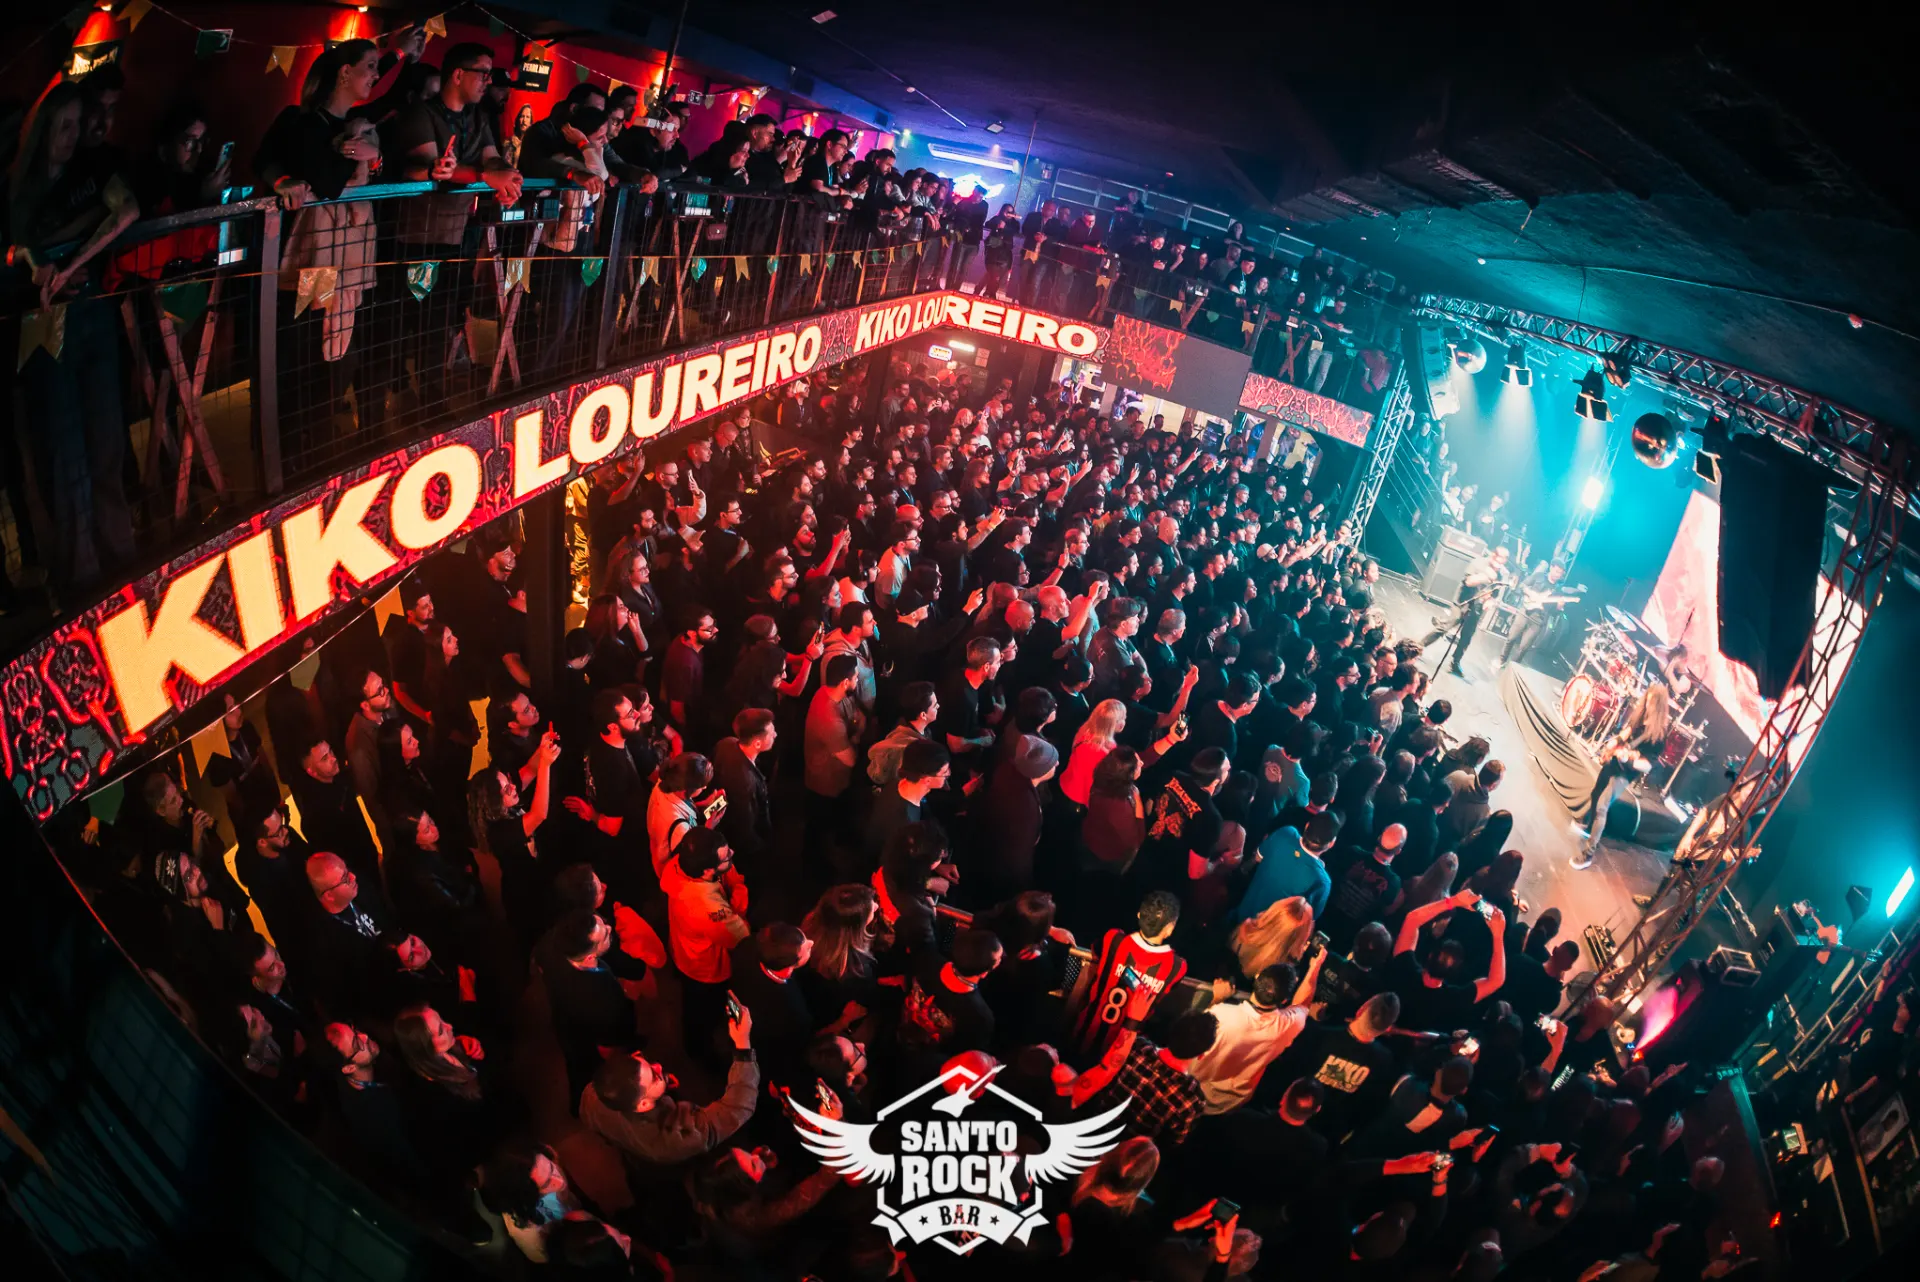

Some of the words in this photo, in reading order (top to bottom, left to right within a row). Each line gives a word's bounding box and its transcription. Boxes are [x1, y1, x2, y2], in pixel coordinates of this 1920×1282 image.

[854, 303, 912, 353] KIKO
[911, 295, 1098, 355] LOUREIRO
[97, 444, 482, 735] KIKO
[513, 325, 822, 499] LOUREIRO
[1102, 987, 1128, 1024] 8
